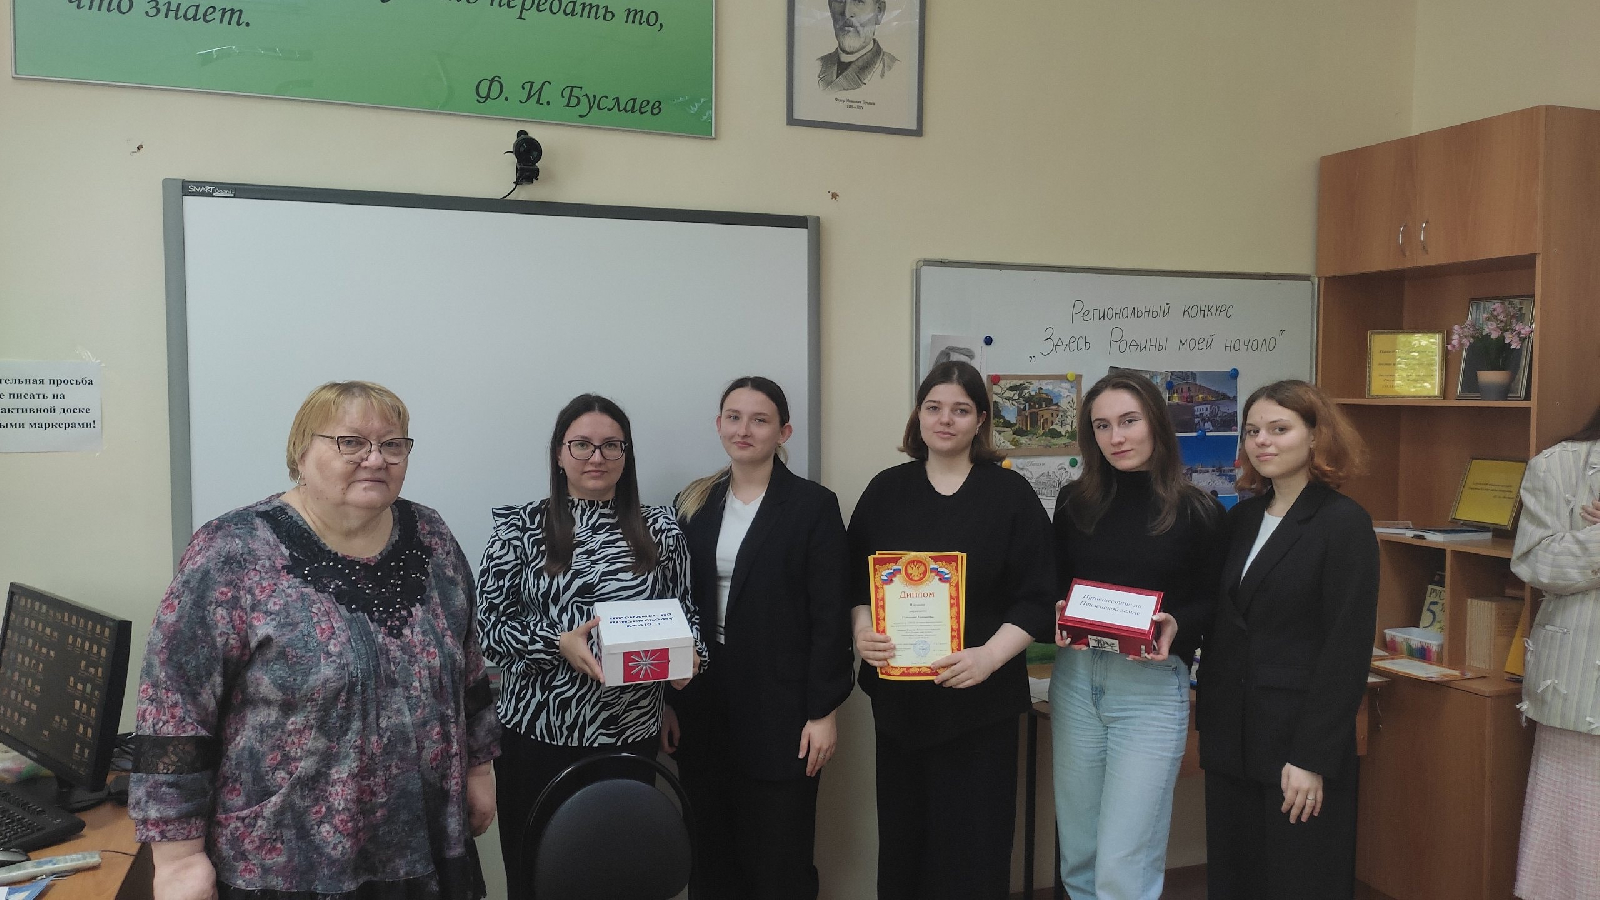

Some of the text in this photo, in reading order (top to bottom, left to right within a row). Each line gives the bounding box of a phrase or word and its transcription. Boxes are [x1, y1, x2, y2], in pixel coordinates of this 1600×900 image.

[145, 0, 250, 28] знает.
[624, 7, 664, 32] то,
[475, 75, 662, 118] Ф. И. Буслаев
[1071, 299, 1234, 324] Региональный конкурс
[1108, 326, 1168, 355] Родины
[1178, 333, 1216, 351] моей
[48, 377, 94, 387] просьба
[8, 392, 49, 400] писать
[52, 392, 66, 400] на
[0, 405, 91, 415] активной доске
[29, 420, 96, 430] маркерами!
[899, 590, 935, 599] Диплом
[1422, 601, 1439, 628] 5
